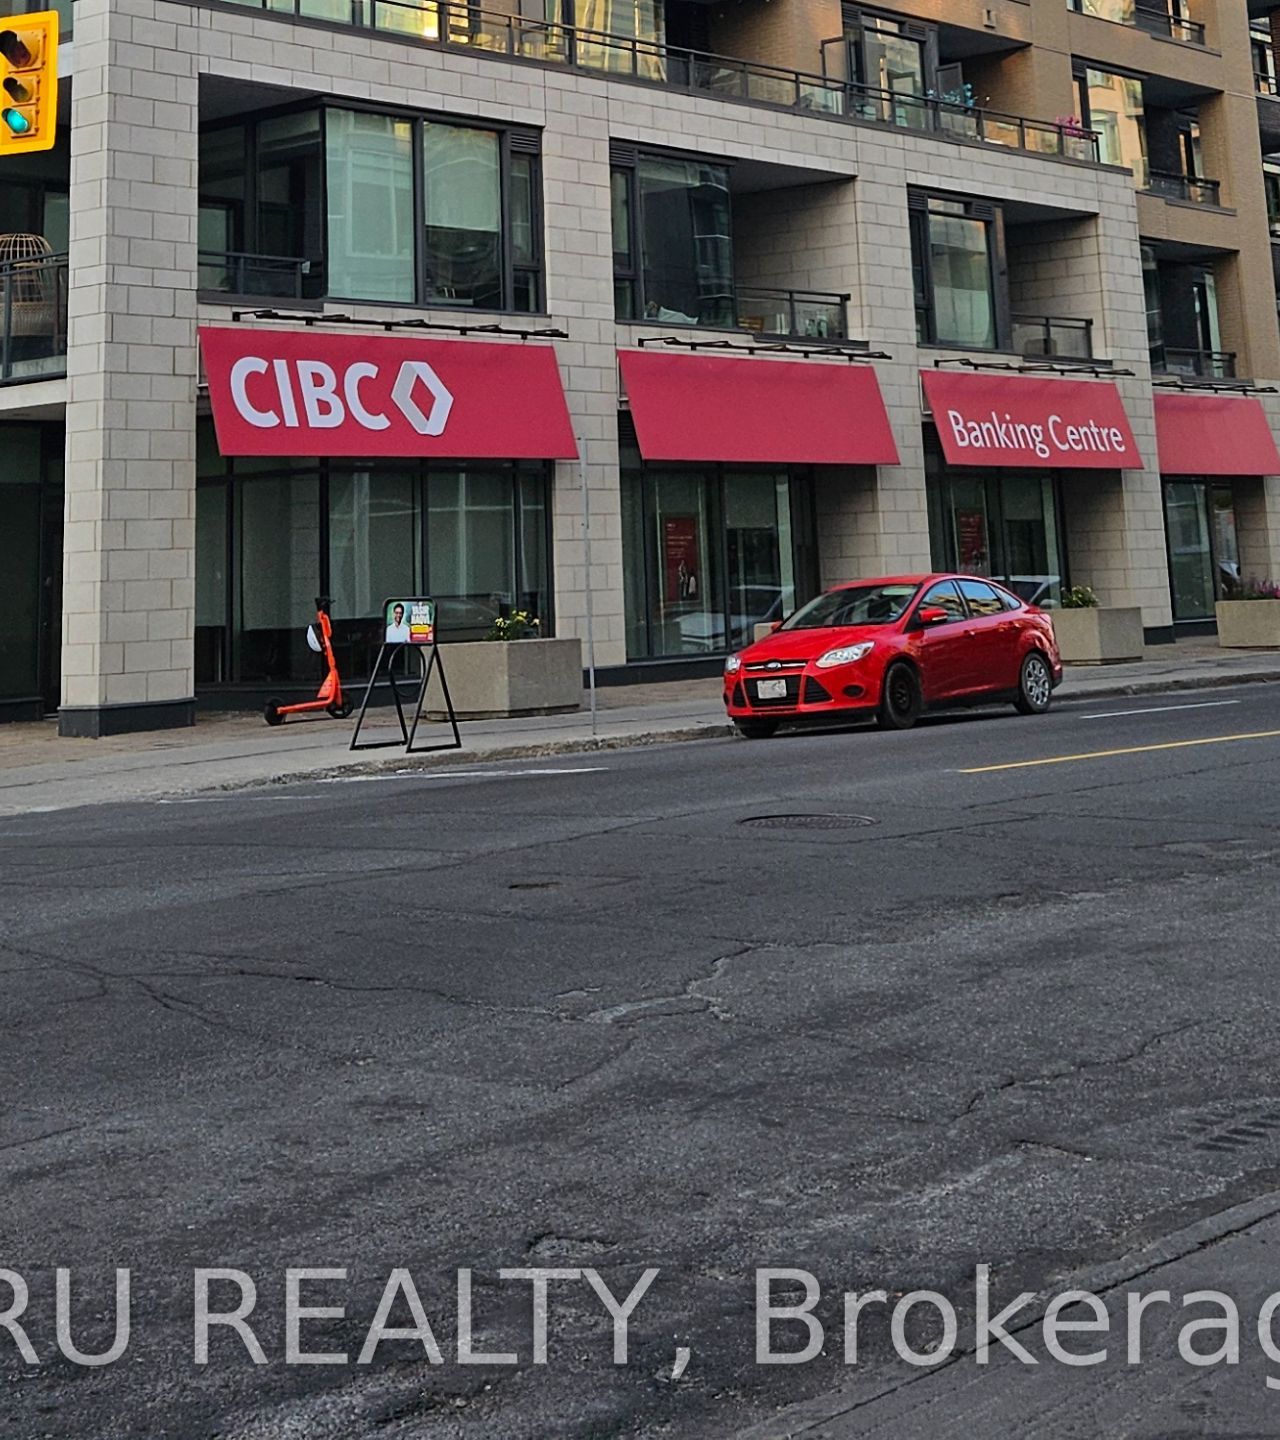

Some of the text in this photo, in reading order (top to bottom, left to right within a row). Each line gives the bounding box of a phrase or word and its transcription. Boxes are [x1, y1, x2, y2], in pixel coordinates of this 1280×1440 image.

[230, 356, 391, 430] CIBC
[948, 410, 1125, 458] Banking Centre
